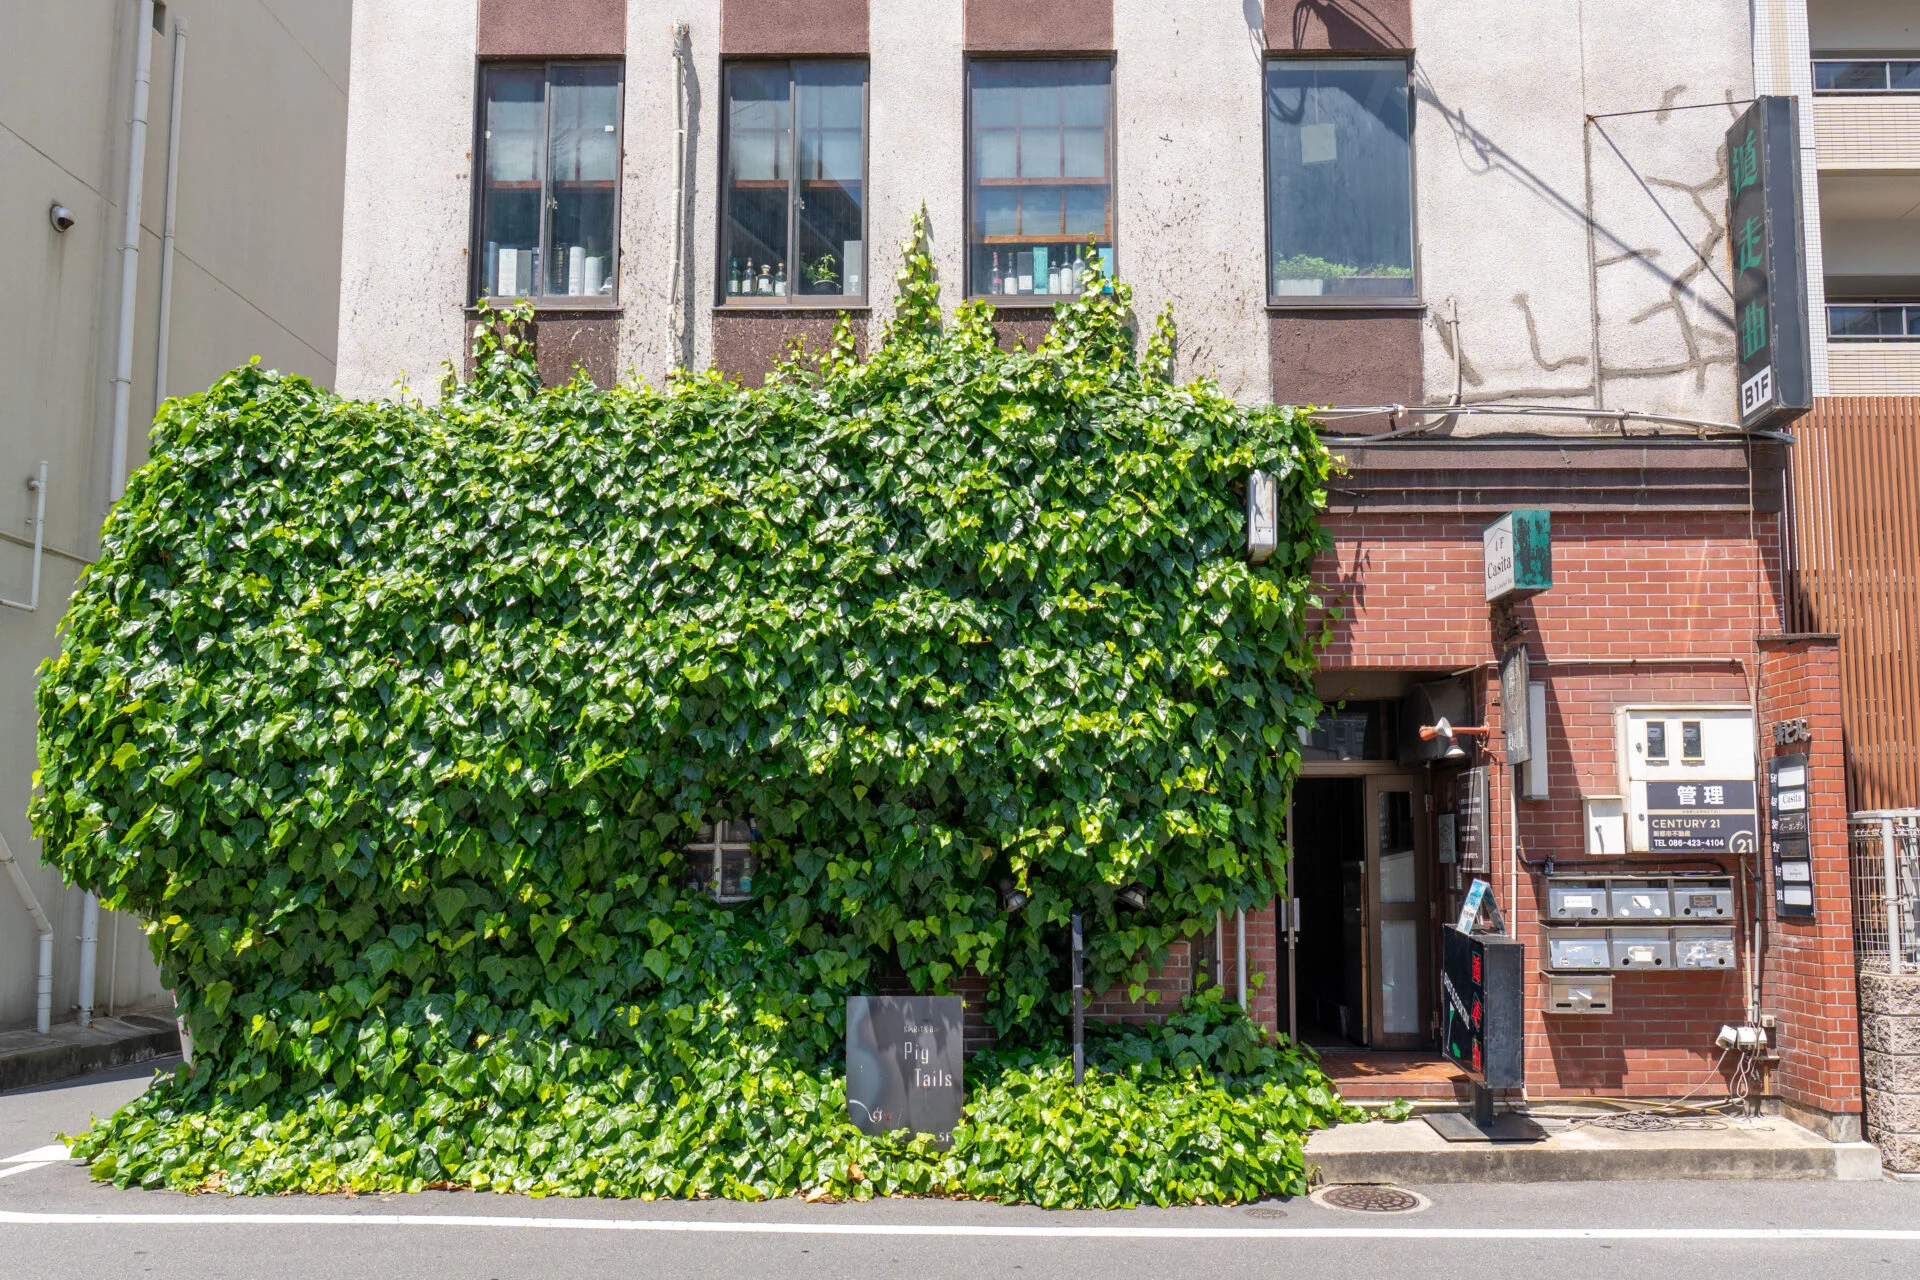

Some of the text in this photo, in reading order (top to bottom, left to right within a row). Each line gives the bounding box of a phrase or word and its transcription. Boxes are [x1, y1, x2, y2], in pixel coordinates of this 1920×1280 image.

[1745, 373, 1769, 409] B1F
[1488, 556, 1512, 579] Casita
[1677, 785, 1724, 805] 管理
[1782, 793, 1802, 804] Casita
[1652, 819, 1721, 828] CENTURY 21
[1654, 839, 1725, 847] TEL 086-423-4104
[1737, 838, 1753, 853] 21
[904, 1041, 929, 1064] Pig
[914, 1068, 953, 1087] Tails
